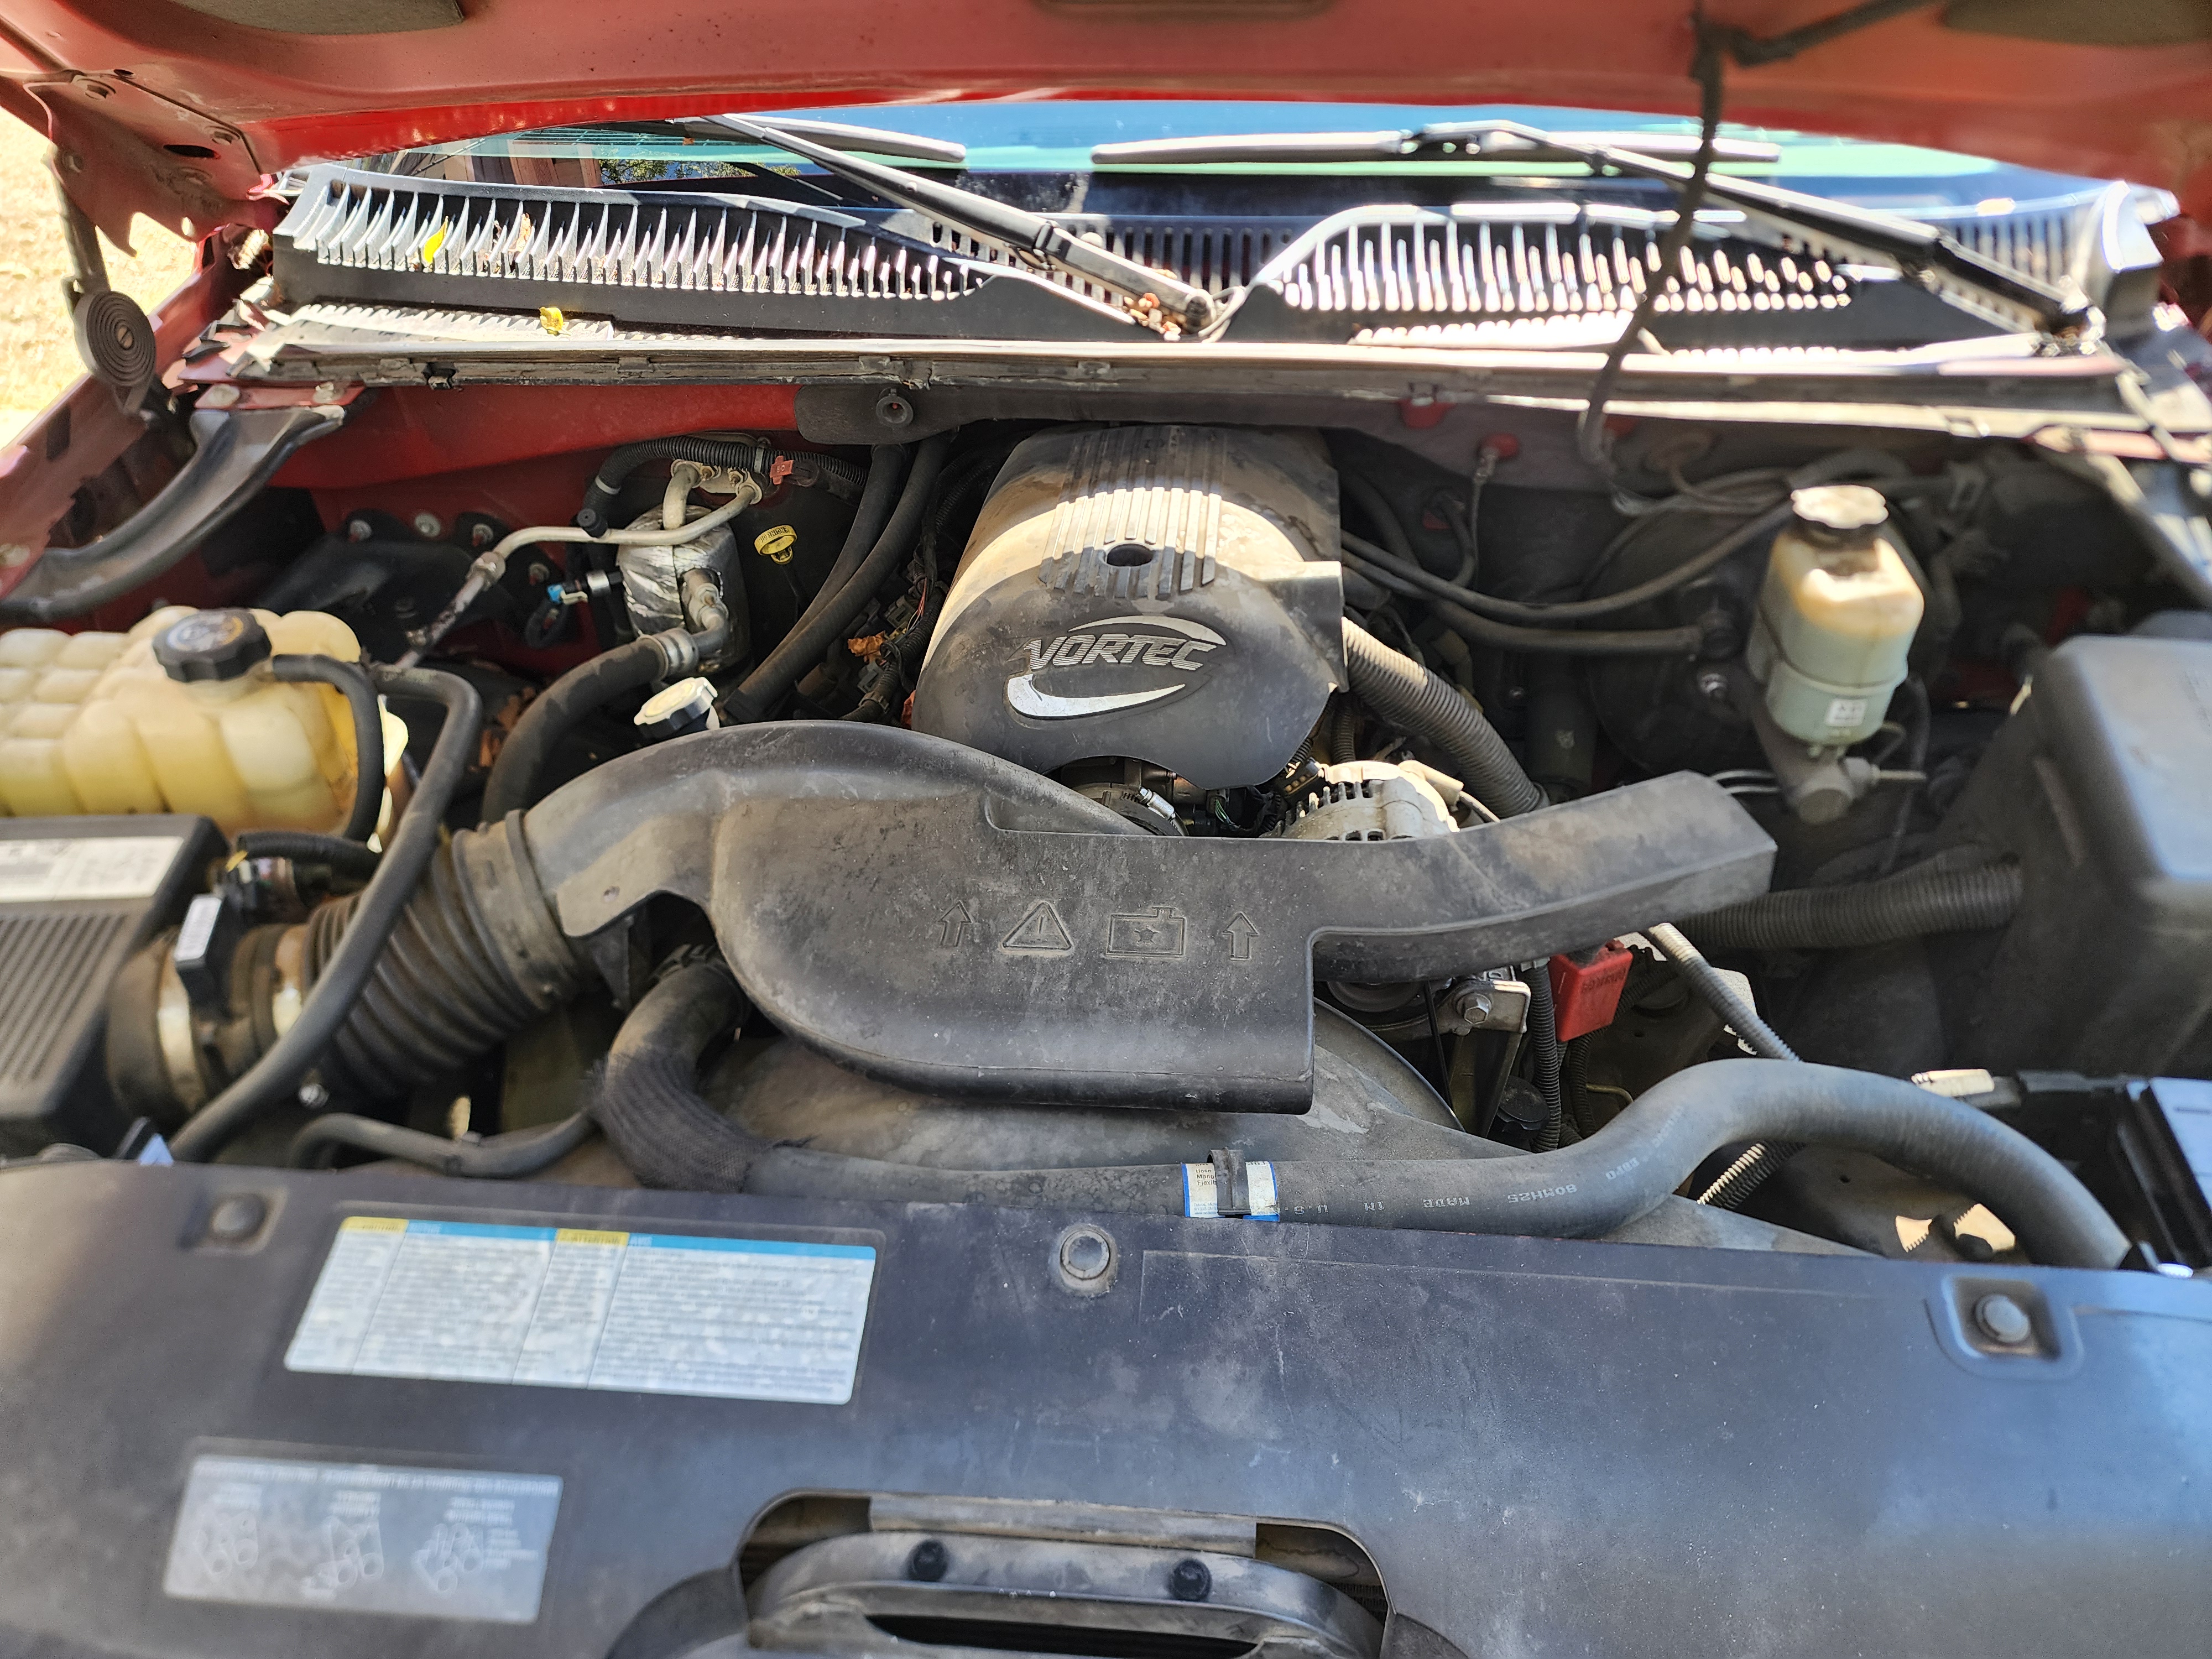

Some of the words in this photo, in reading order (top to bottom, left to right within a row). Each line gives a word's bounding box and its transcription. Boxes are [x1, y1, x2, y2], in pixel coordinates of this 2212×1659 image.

[1023, 634, 1217, 671] VORTEC
[1507, 1183, 1577, 1203] 80MH25
[1364, 1201, 1385, 1212] IN
[1423, 1197, 1471, 1208] MADE
